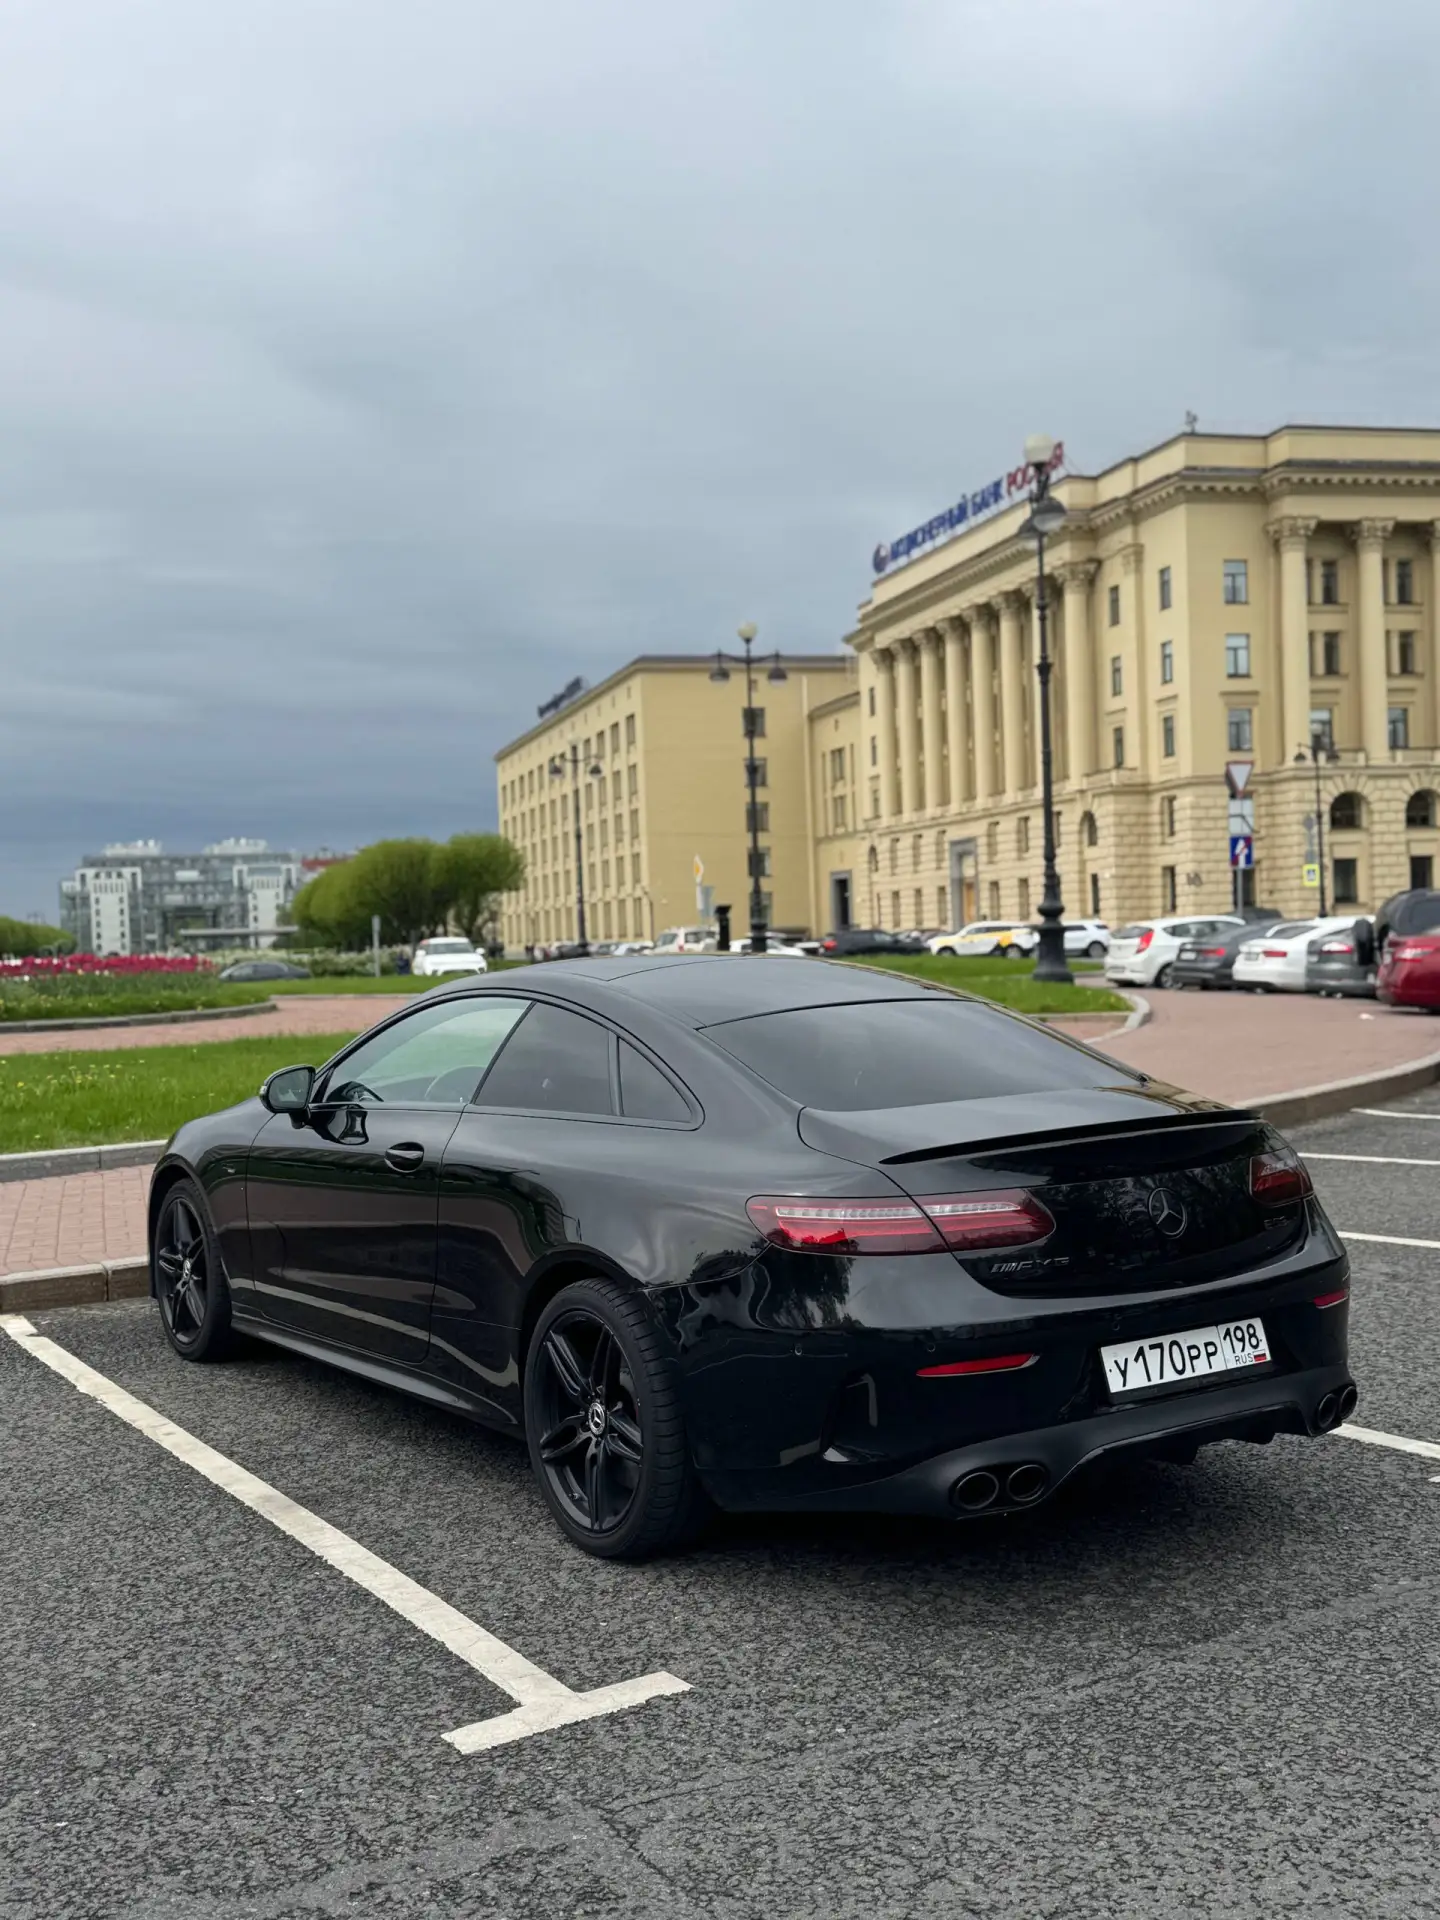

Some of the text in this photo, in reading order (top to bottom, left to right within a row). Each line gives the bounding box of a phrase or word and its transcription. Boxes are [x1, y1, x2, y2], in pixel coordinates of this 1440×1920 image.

[1114, 1323, 1260, 1388] У170РР 198
[1234, 1352, 1254, 1365] RUS
